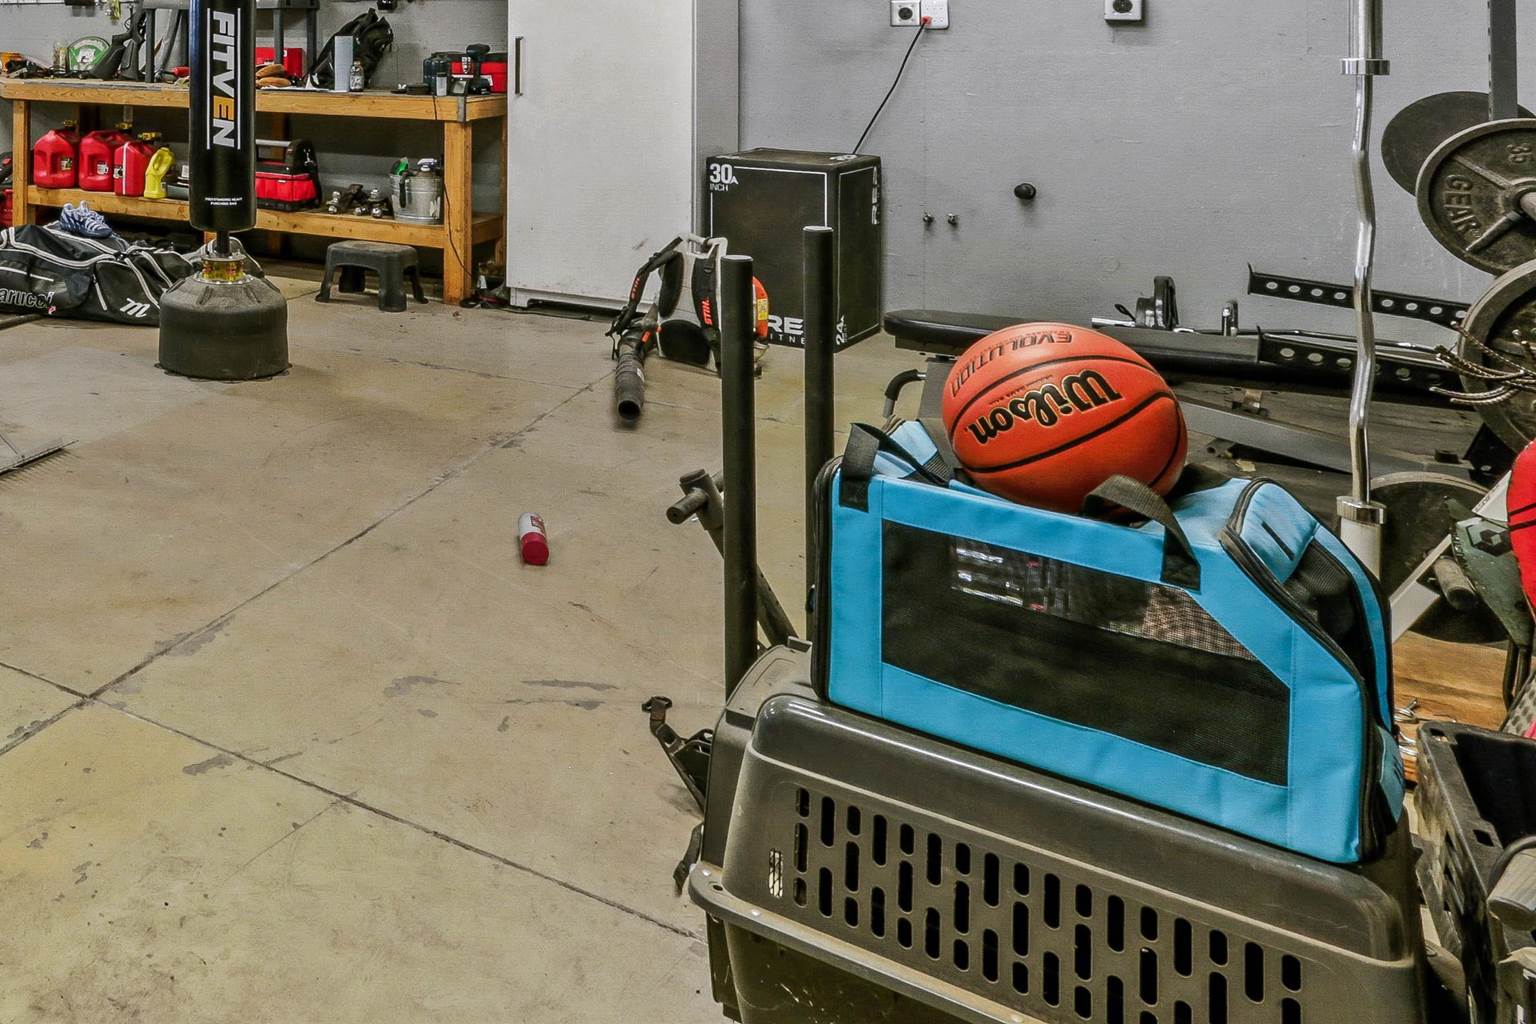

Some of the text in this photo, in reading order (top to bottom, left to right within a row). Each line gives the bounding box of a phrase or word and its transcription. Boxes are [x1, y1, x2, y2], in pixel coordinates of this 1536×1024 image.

[213, 10, 235, 148] FITVEN
[951, 330, 1074, 398] EVOLUTION
[967, 369, 1123, 445] Wilson
